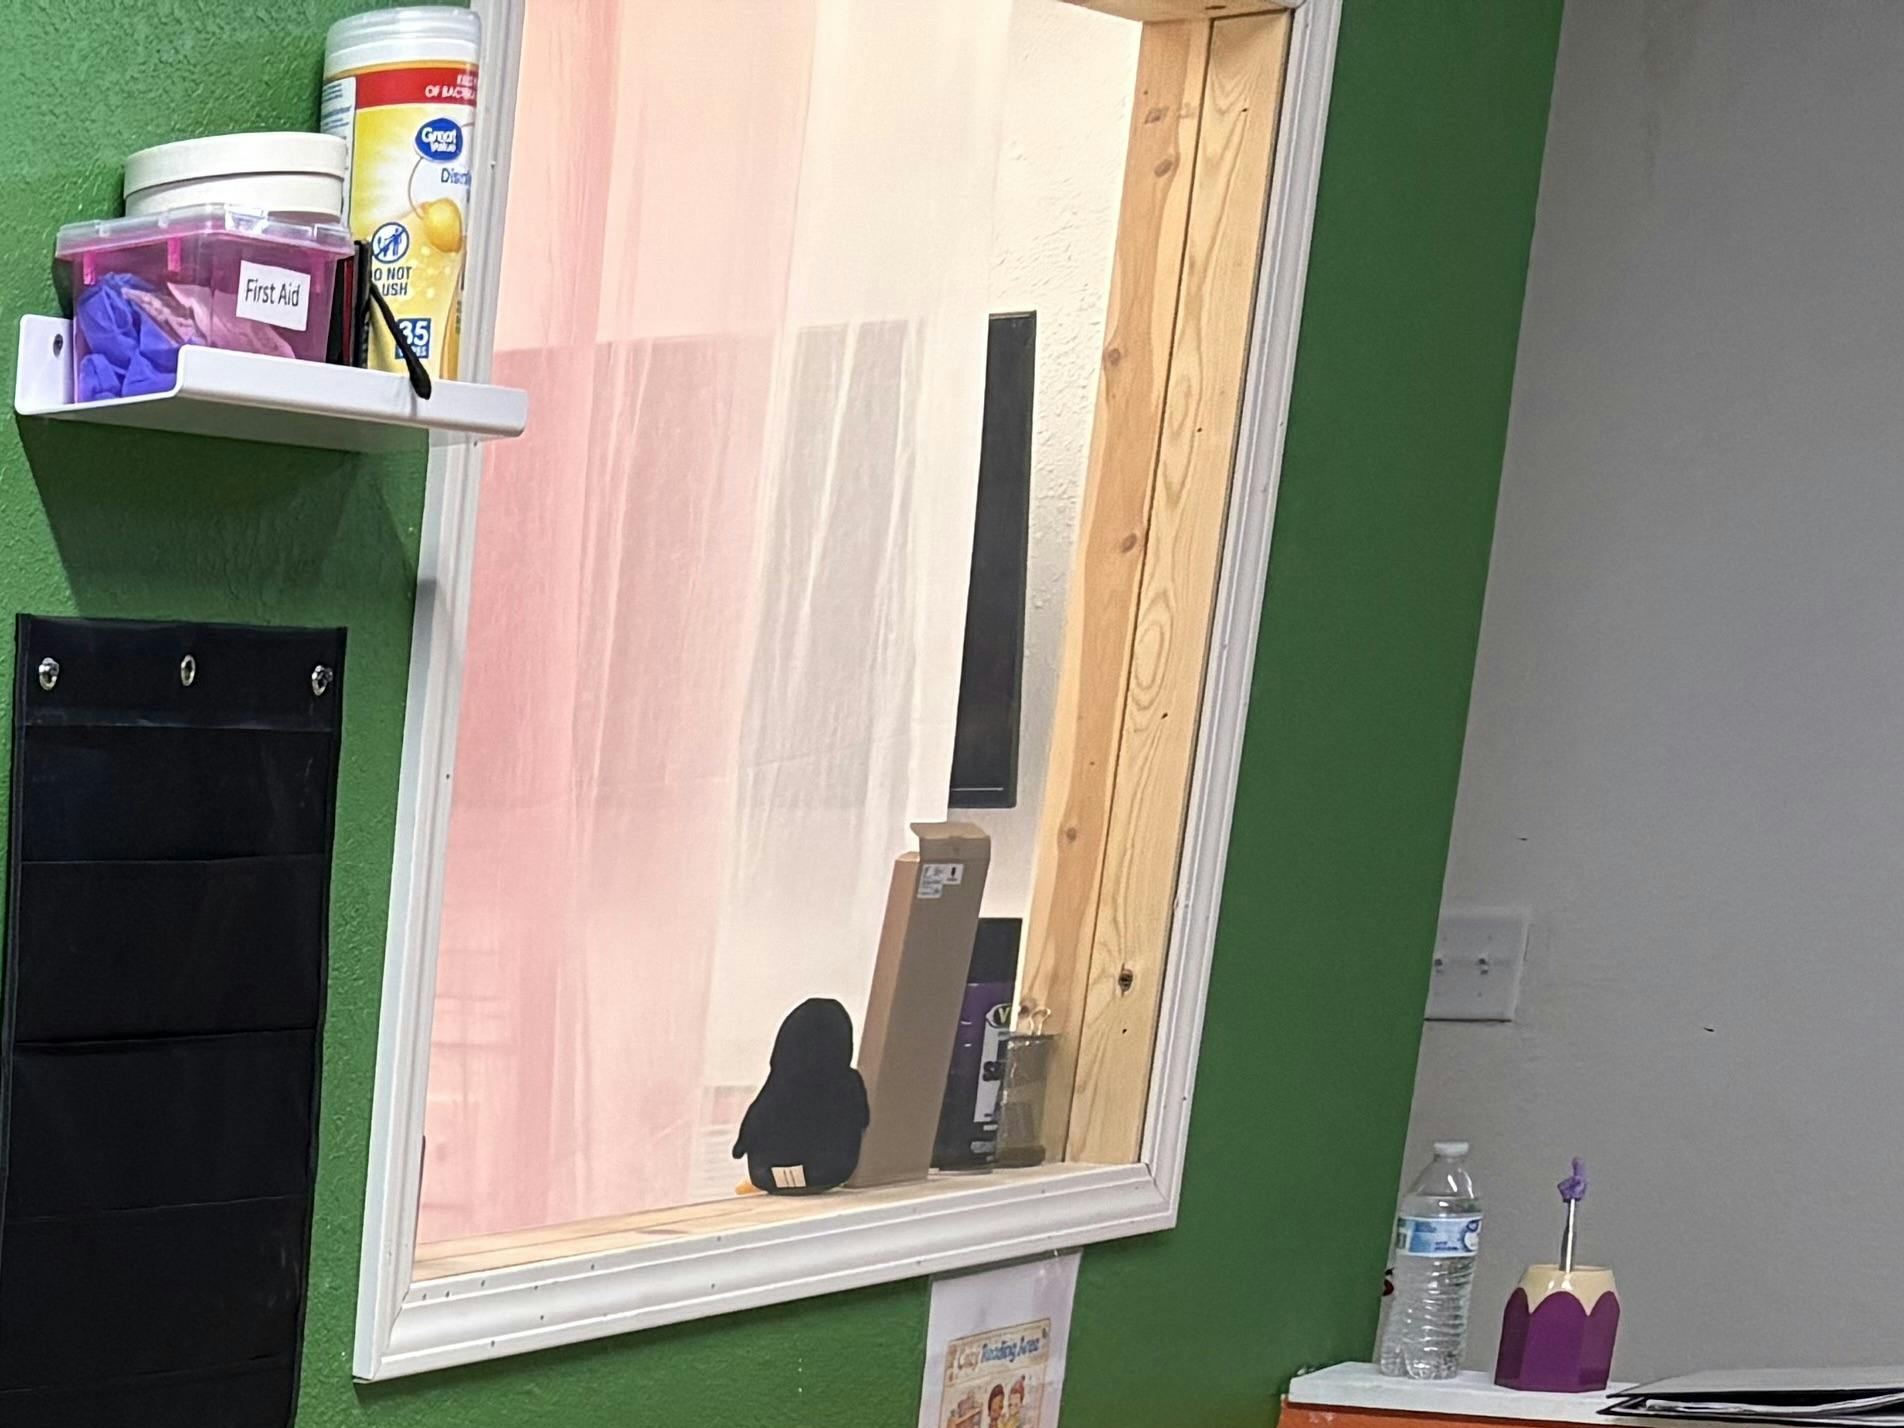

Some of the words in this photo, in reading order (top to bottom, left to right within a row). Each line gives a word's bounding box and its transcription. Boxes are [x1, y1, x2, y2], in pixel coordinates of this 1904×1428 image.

[422, 127, 457, 144] Great
[386, 266, 412, 281] NOT
[245, 278, 276, 304] First
[278, 282, 300, 307] Aid
[398, 320, 429, 346] 35
